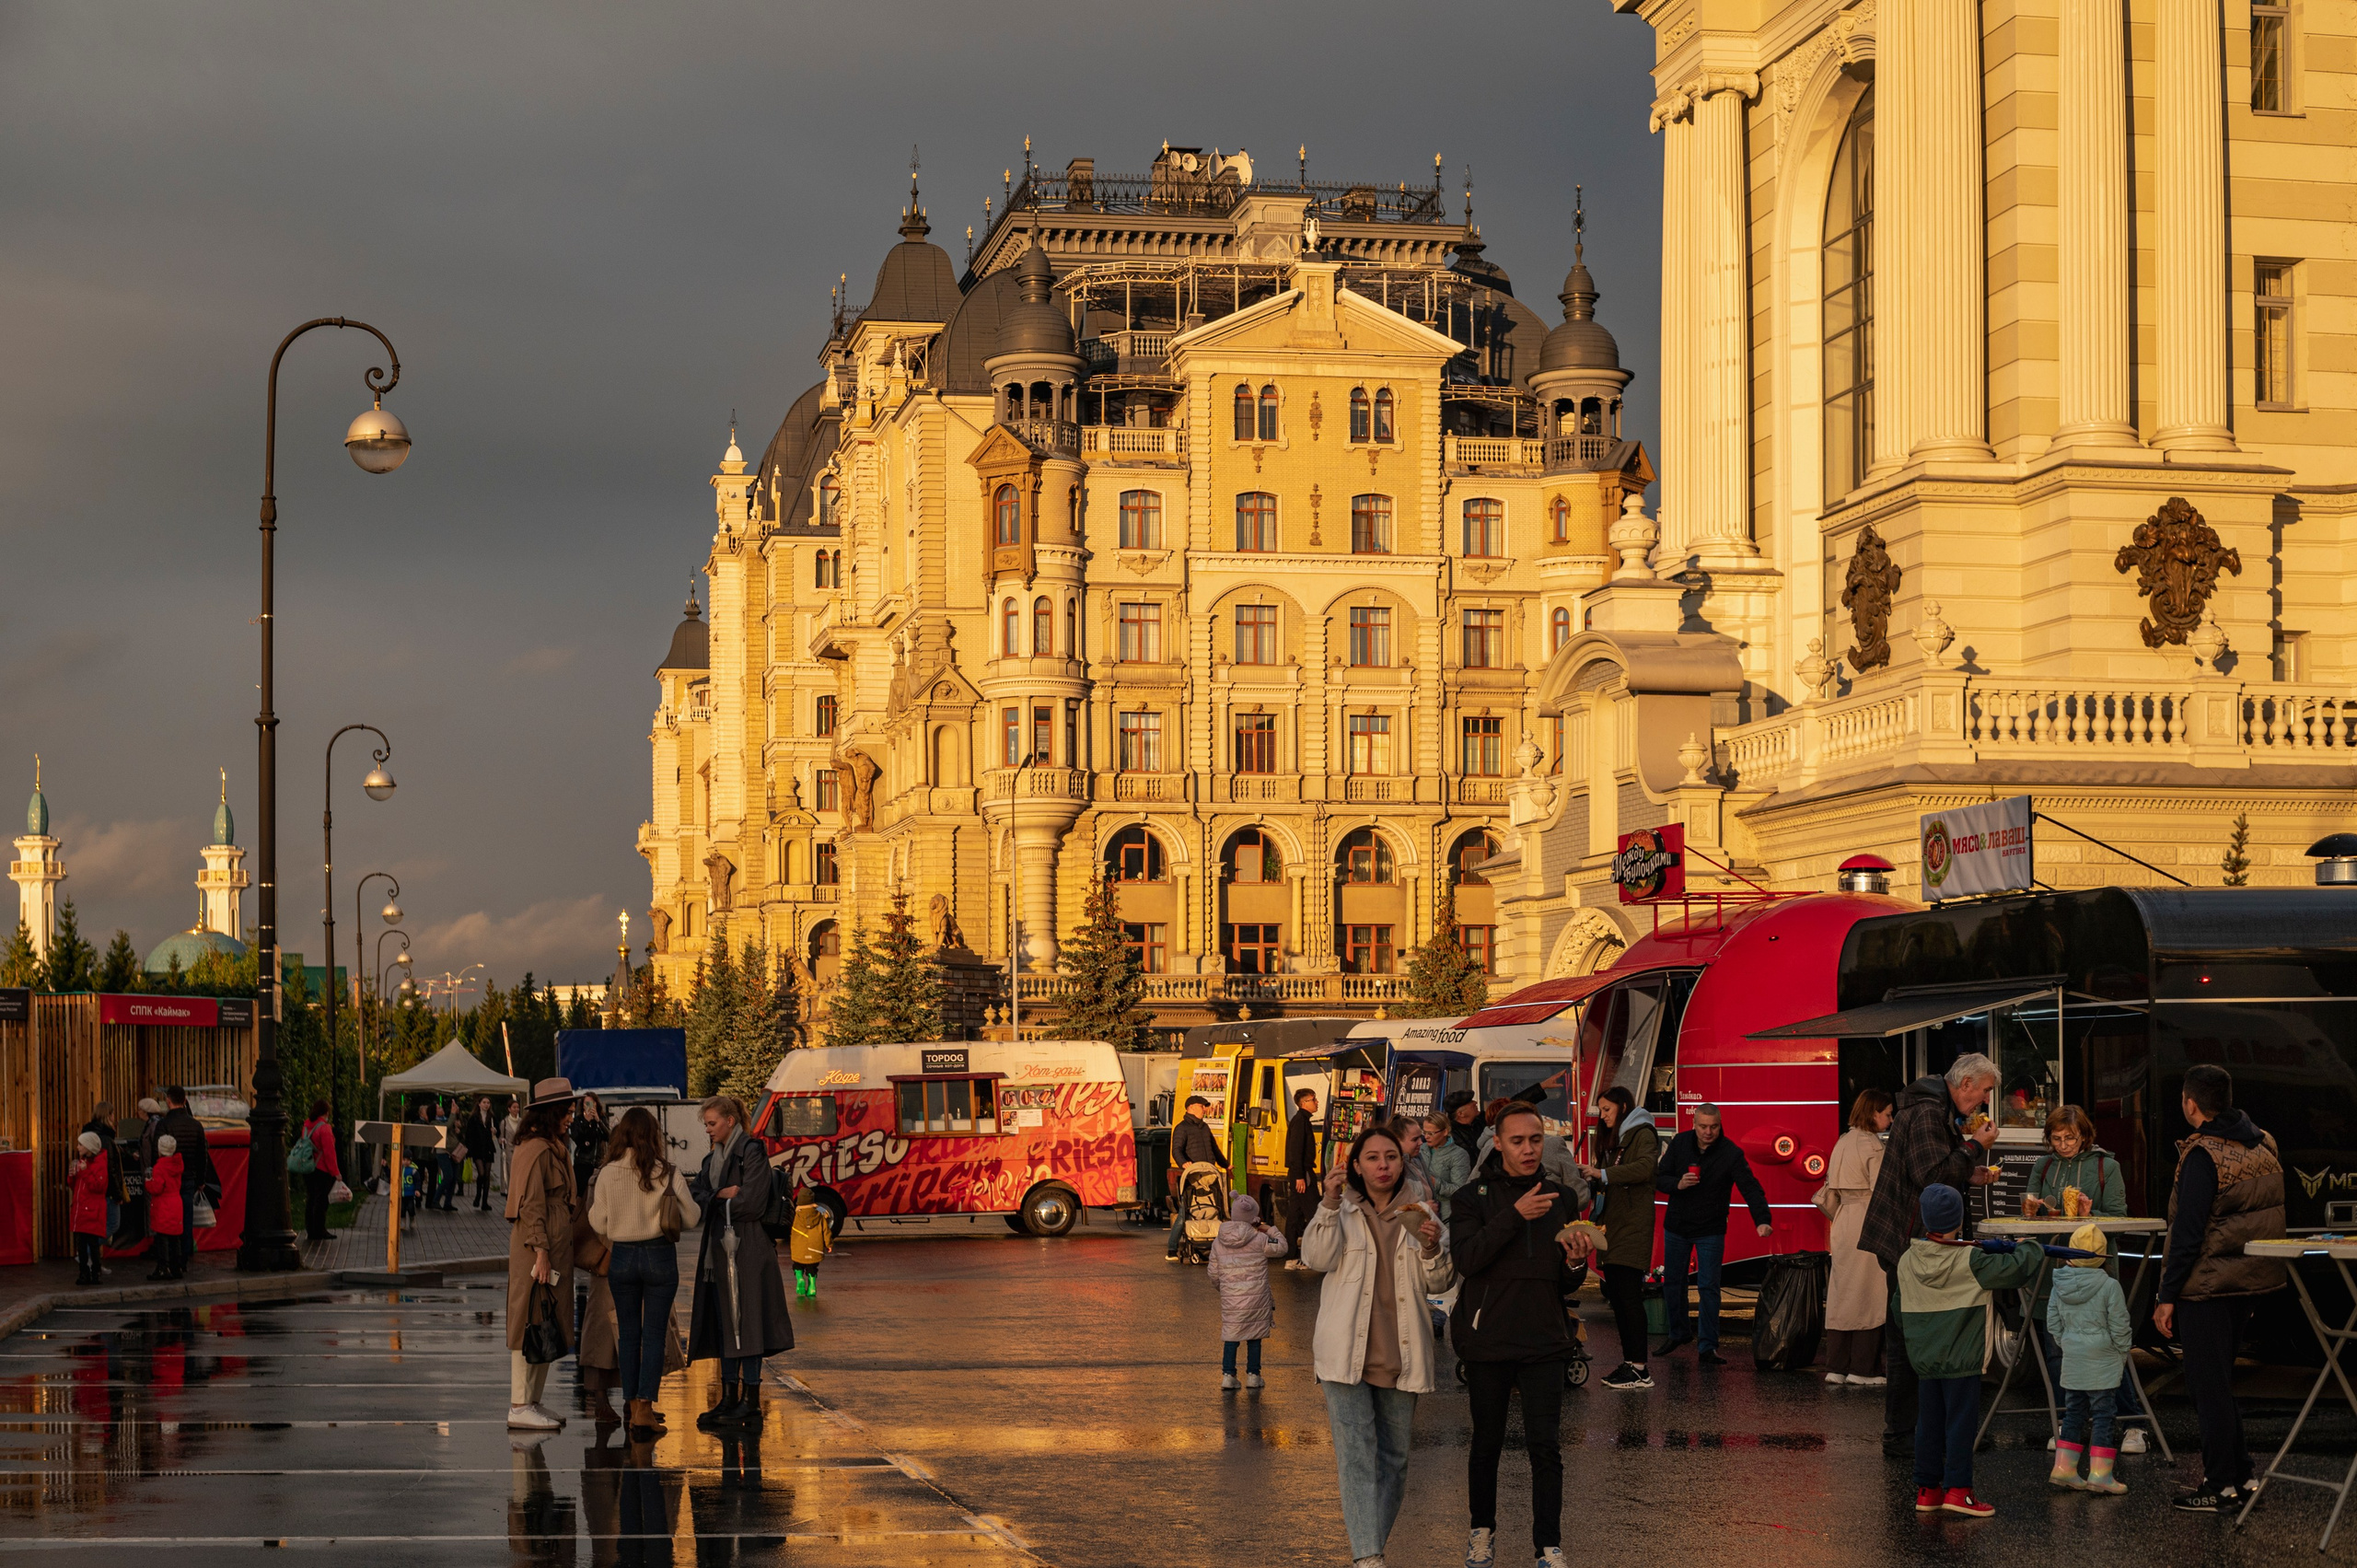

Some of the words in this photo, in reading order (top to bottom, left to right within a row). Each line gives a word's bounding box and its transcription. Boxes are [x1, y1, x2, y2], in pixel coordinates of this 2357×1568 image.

[1610, 843, 1644, 883] Между
[130, 1005, 152, 1016] СППК
[154, 1006, 191, 1017] «Каймак»
[1401, 1027, 1439, 1041] Amazing
[1436, 1028, 1469, 1043] food
[925, 1053, 964, 1063] TOPDOG
[818, 1069, 861, 1086] Кофе
[1411, 1077, 1431, 1090] ЗАКАЗ
